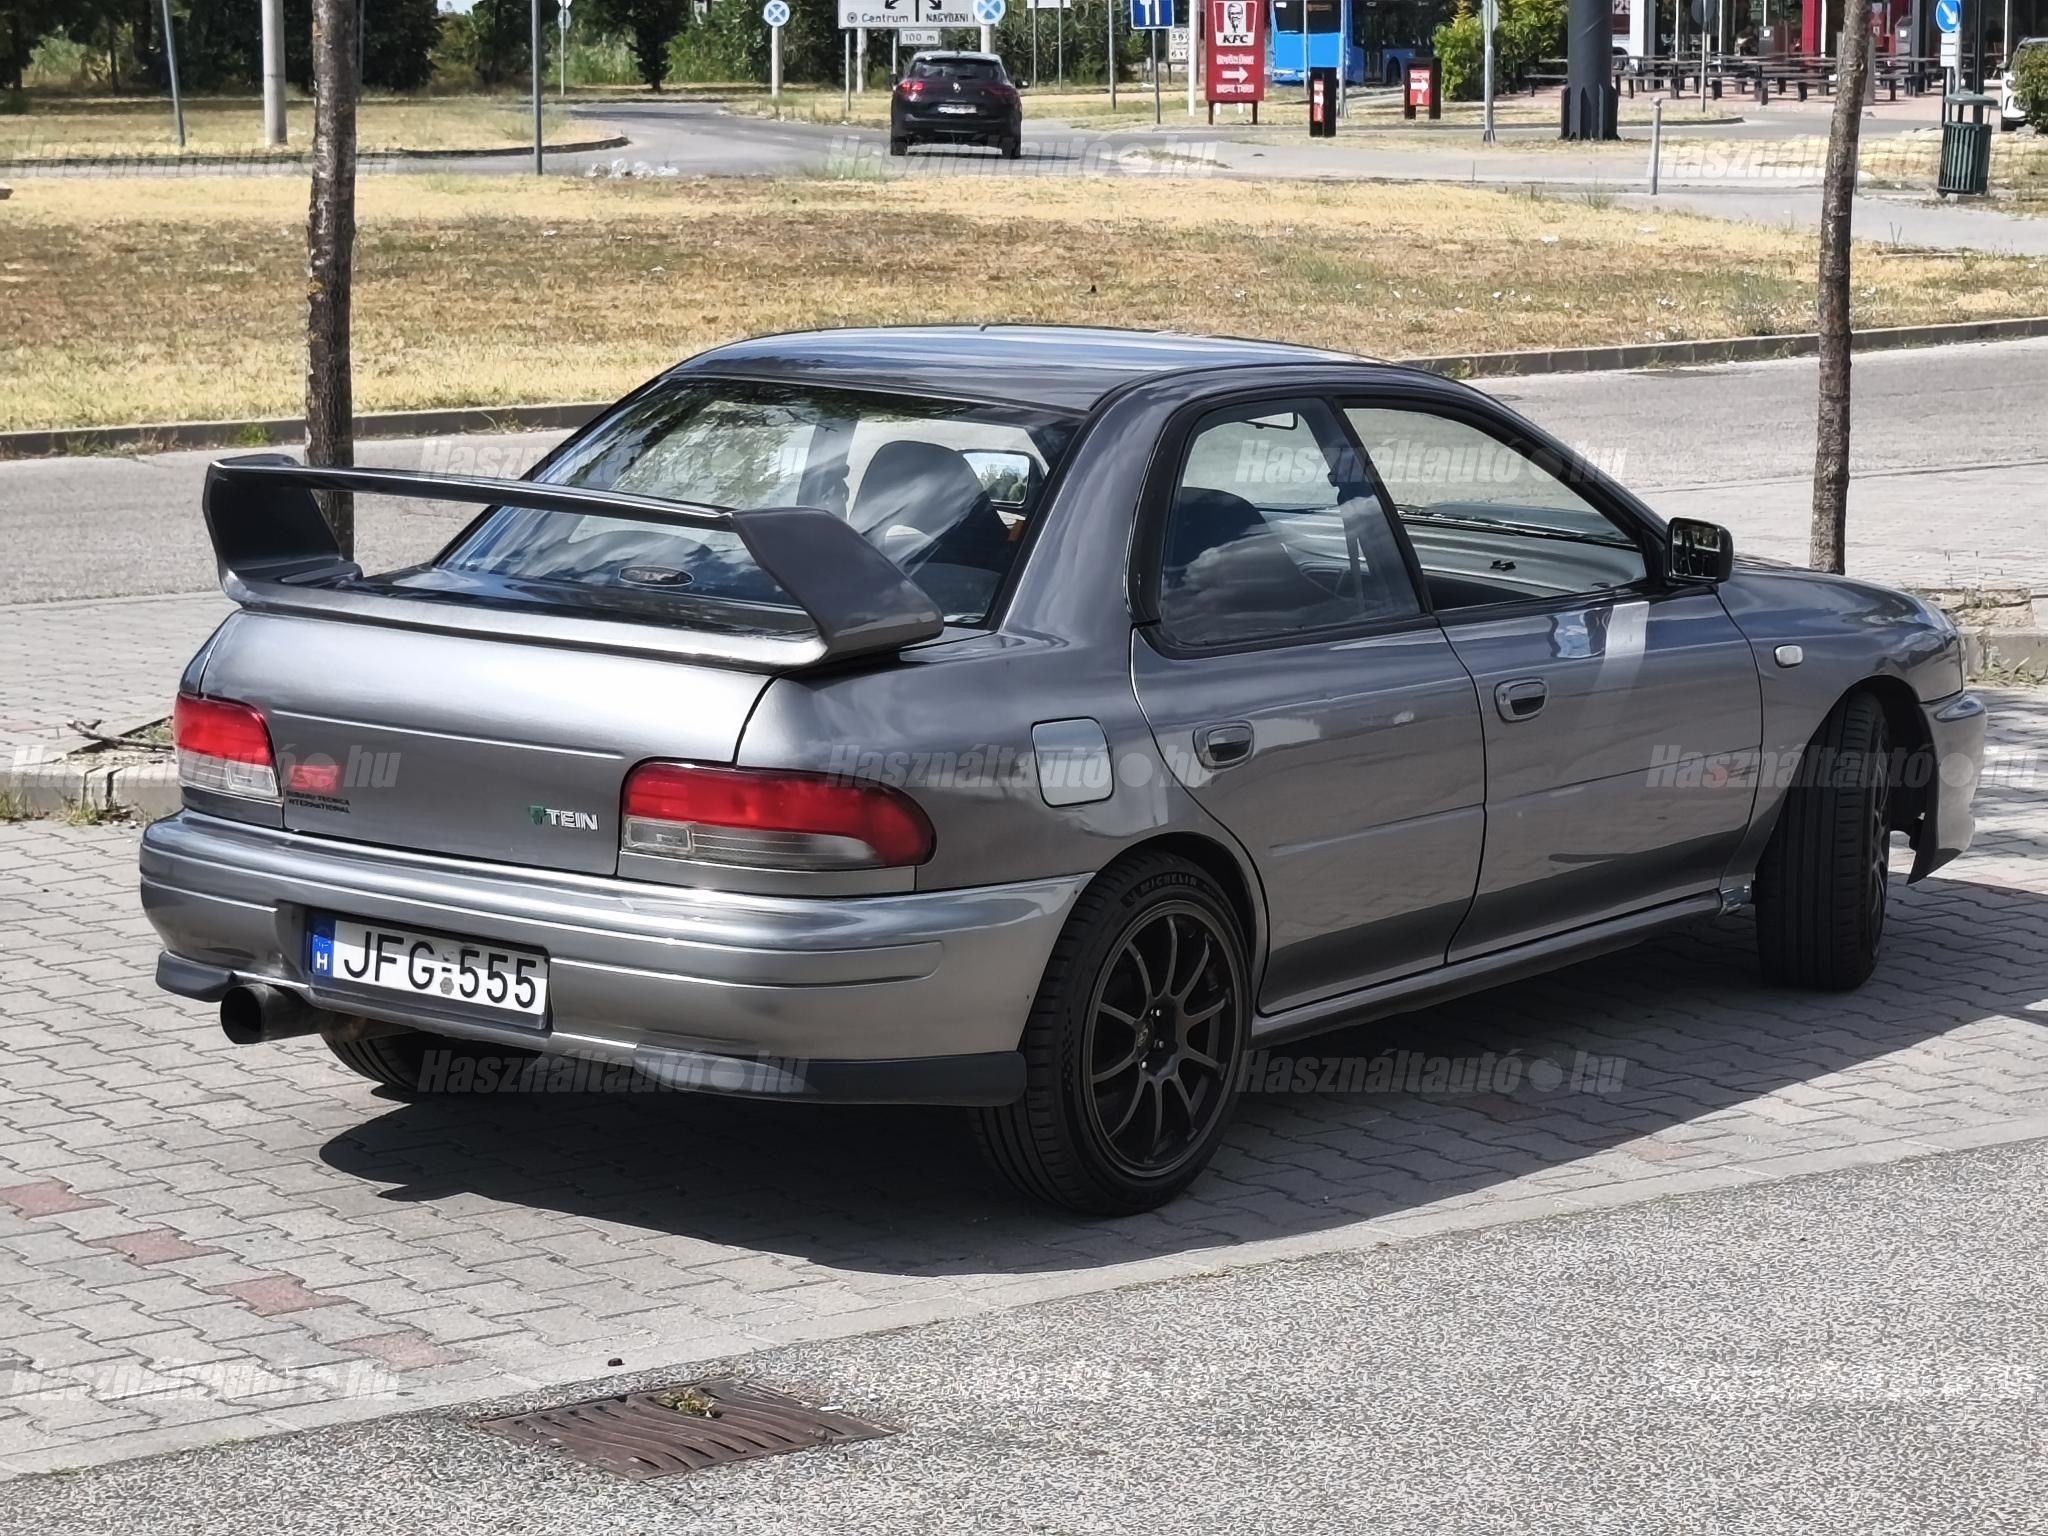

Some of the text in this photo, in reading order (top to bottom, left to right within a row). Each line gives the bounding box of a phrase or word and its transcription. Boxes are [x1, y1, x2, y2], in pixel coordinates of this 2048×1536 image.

[861, 13, 909, 23] Centrum
[904, 33, 922, 42] 100
[1222, 34, 1249, 44] KFC
[544, 808, 599, 831] TEIN
[1141, 873, 1198, 892] MICHELIN
[316, 951, 329, 971] H
[343, 930, 537, 1010] JFG-555
